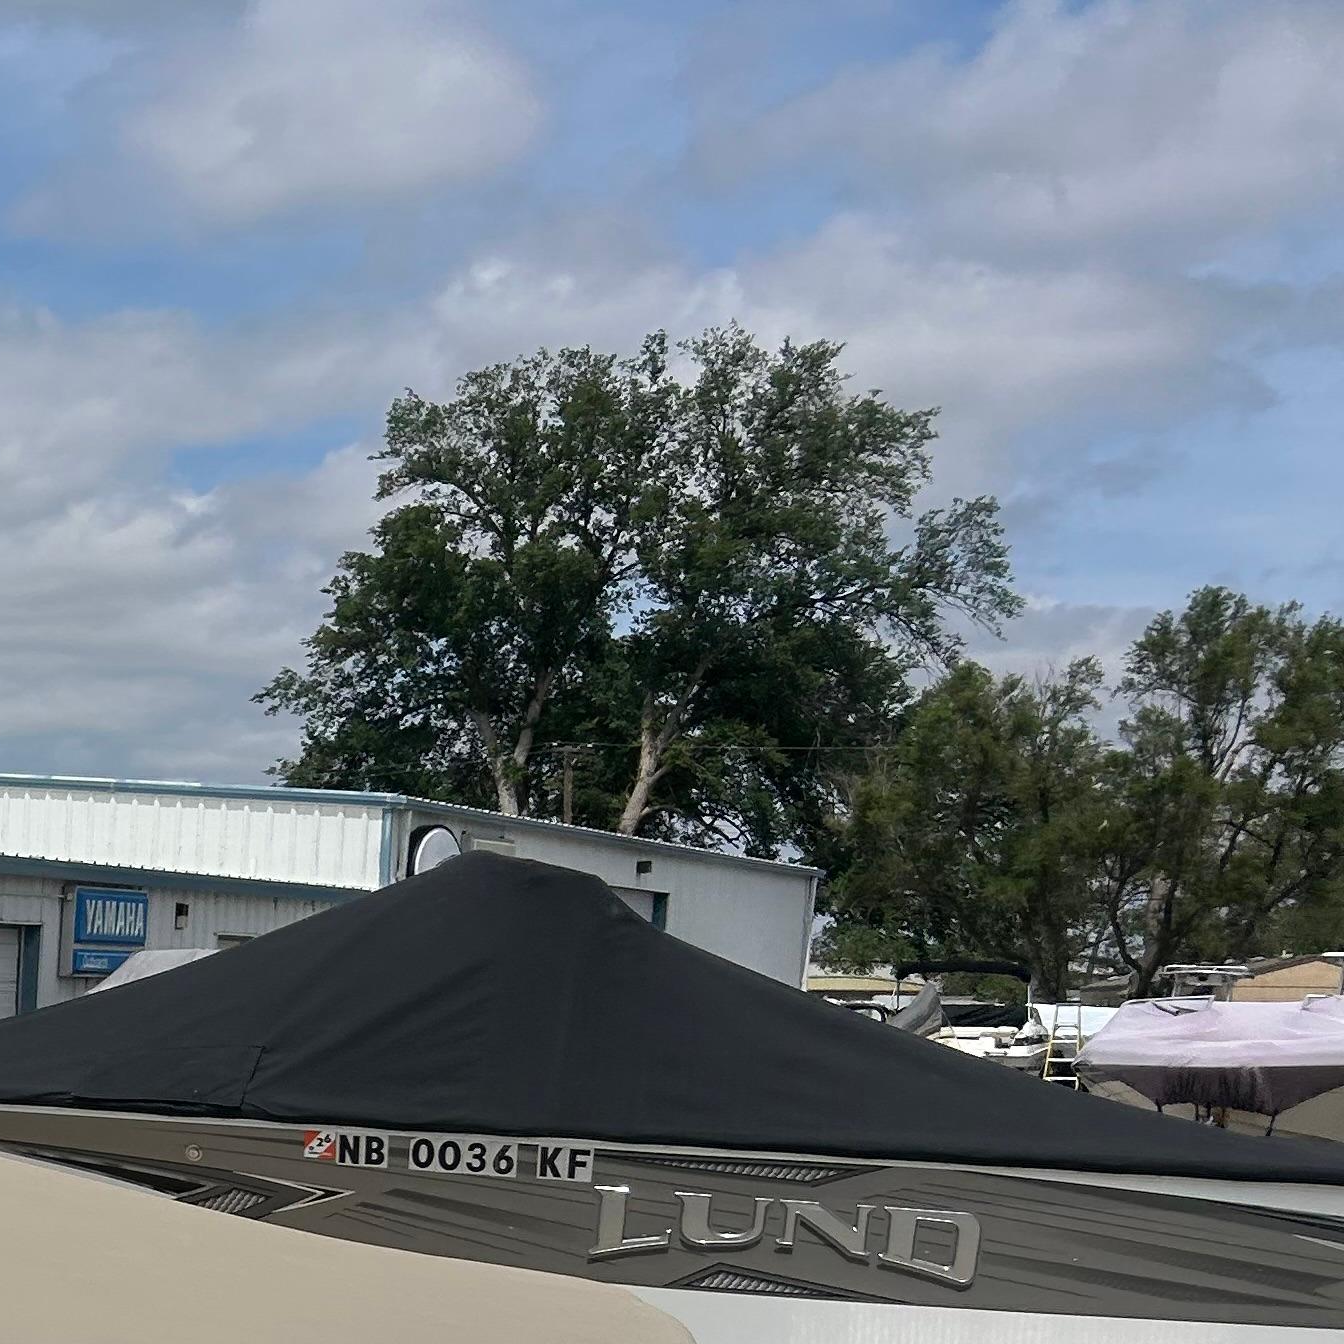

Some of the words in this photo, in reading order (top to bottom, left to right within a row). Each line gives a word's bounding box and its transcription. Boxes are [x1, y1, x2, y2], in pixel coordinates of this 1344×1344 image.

[86, 899, 144, 937] YAMAHA
[338, 1134, 386, 1165] NB
[412, 1137, 515, 1175] 0036
[539, 1146, 592, 1179] KF
[587, 1184, 984, 1292] LUND
